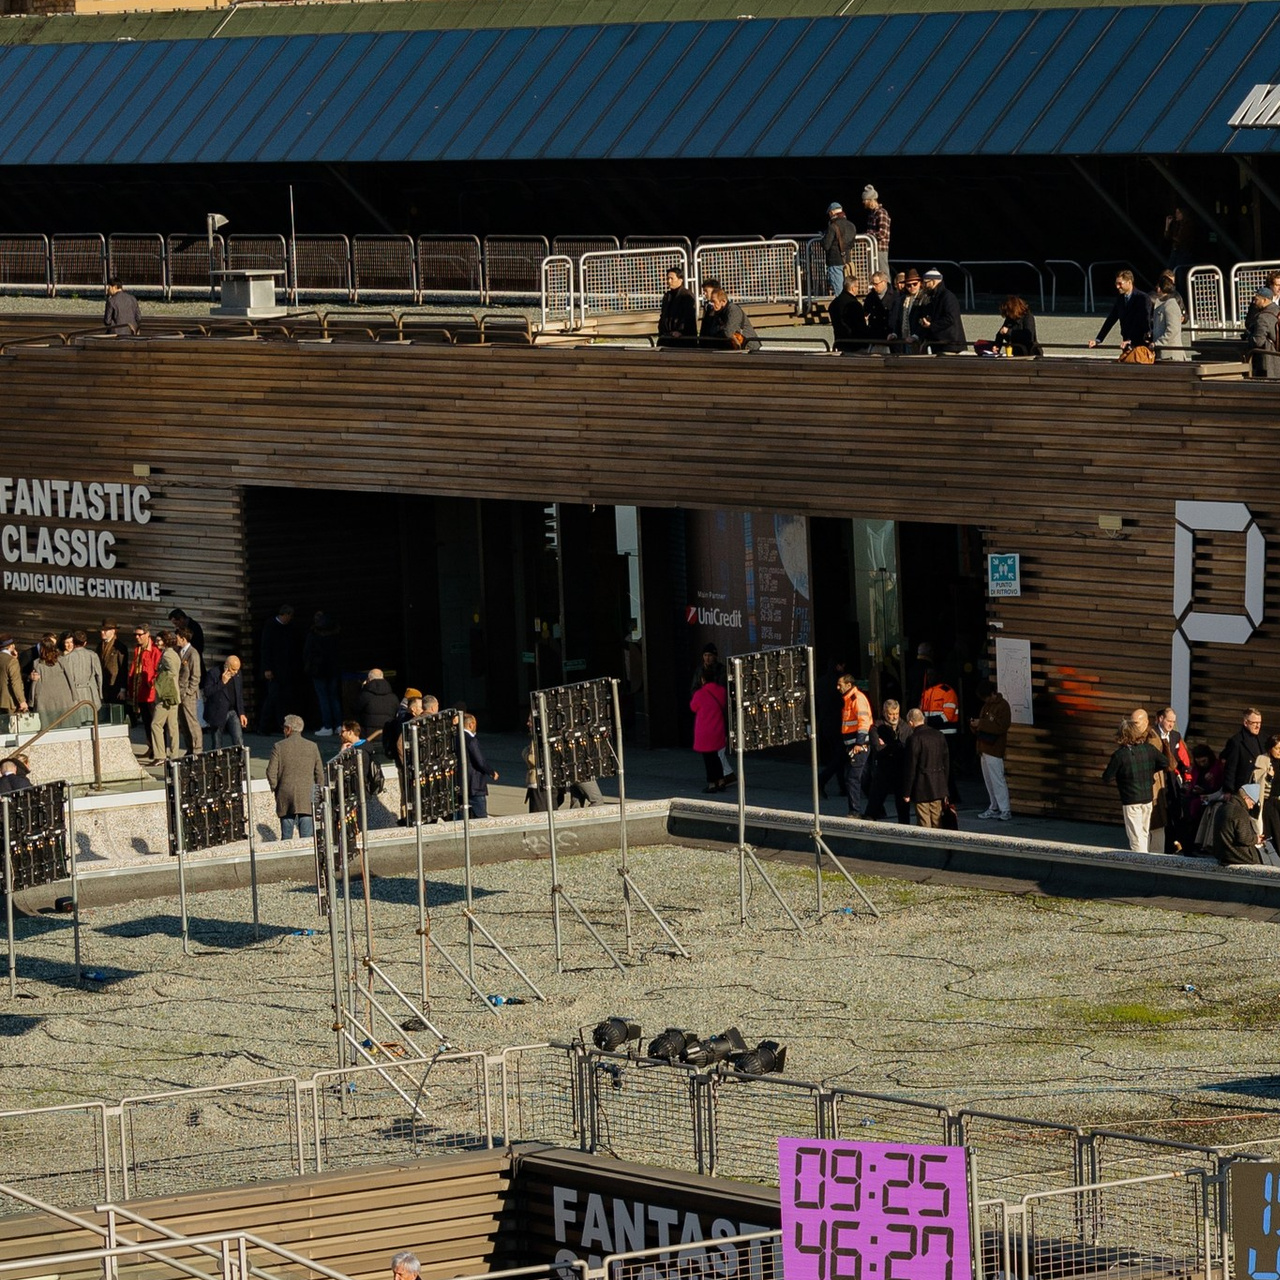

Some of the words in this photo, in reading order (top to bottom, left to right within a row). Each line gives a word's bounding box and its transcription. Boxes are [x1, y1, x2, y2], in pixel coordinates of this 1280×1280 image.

[0, 477, 151, 525] FANTASTIC
[1, 524, 117, 570] CLASSIC
[3, 570, 85, 597] PADIGLIONE
[87, 577, 161, 602] CENTRALE
[697, 606, 742, 629] UniCredit
[794, 1146, 950, 1219] 09:25
